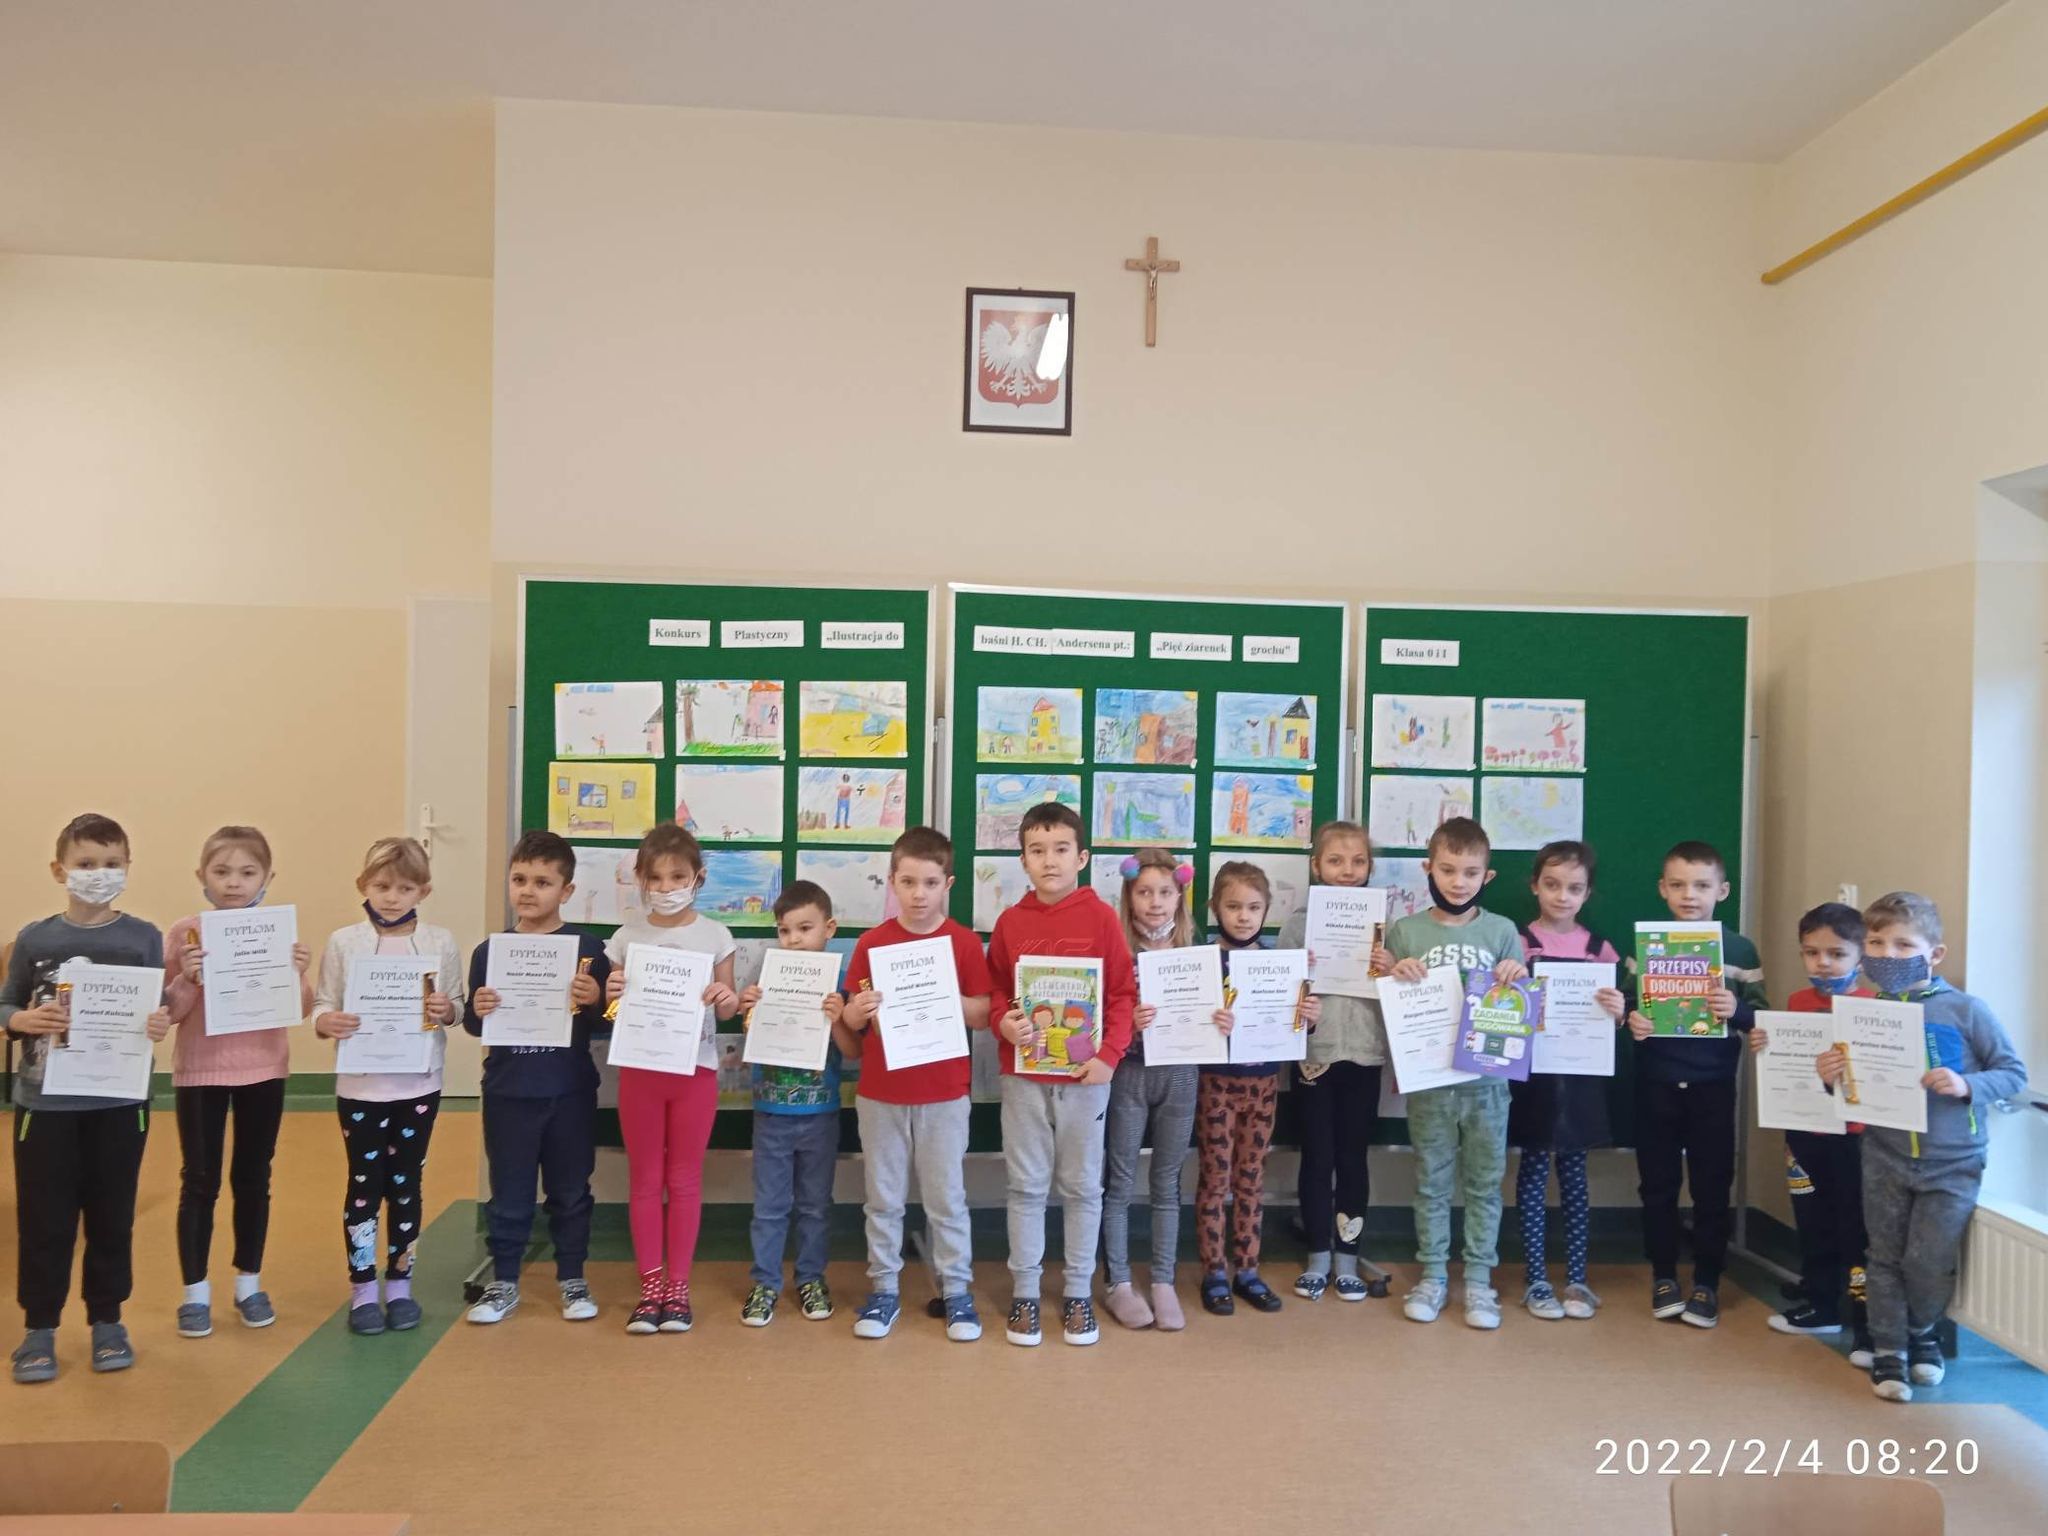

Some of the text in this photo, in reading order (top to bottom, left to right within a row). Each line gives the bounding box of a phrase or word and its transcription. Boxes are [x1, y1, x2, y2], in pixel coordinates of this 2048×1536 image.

[655, 627, 701, 639] Konkurs
[734, 630, 789, 641] Plastyczny
[886, 631, 899, 641] do
[981, 634, 1008, 646] baśni
[1011, 635, 1024, 647] H.
[1026, 637, 1047, 648] CH.
[1057, 638, 1110, 649] Andersena
[1185, 643, 1227, 653] ziarenek
[1396, 648, 1424, 658] Klasa
[1436, 649, 1440, 658] i
[1326, 901, 1368, 912] DYPLOM
[224, 923, 276, 937] DYPLOM
[509, 948, 558, 959] DYPLOM
[644, 962, 692, 978] DYPLOM
[780, 965, 822, 977] DYPLOM
[890, 956, 936, 972] DYPLOM
[1158, 963, 1203, 976] DYPLOM
[1248, 965, 1291, 976] DYPLOM
[1648, 959, 1711, 976] PRZEPISY
[370, 970, 419, 982] DYPLOM
[1553, 978, 1597, 988] DYPLOM
[83, 982, 141, 996] DYPLOM
[1399, 983, 1444, 1000] DYPLOM
[1651, 978, 1710, 995] DROGOWE
[1854, 1014, 1904, 1030] DYPLOM
[1775, 1027, 1824, 1040] DYPLOM
